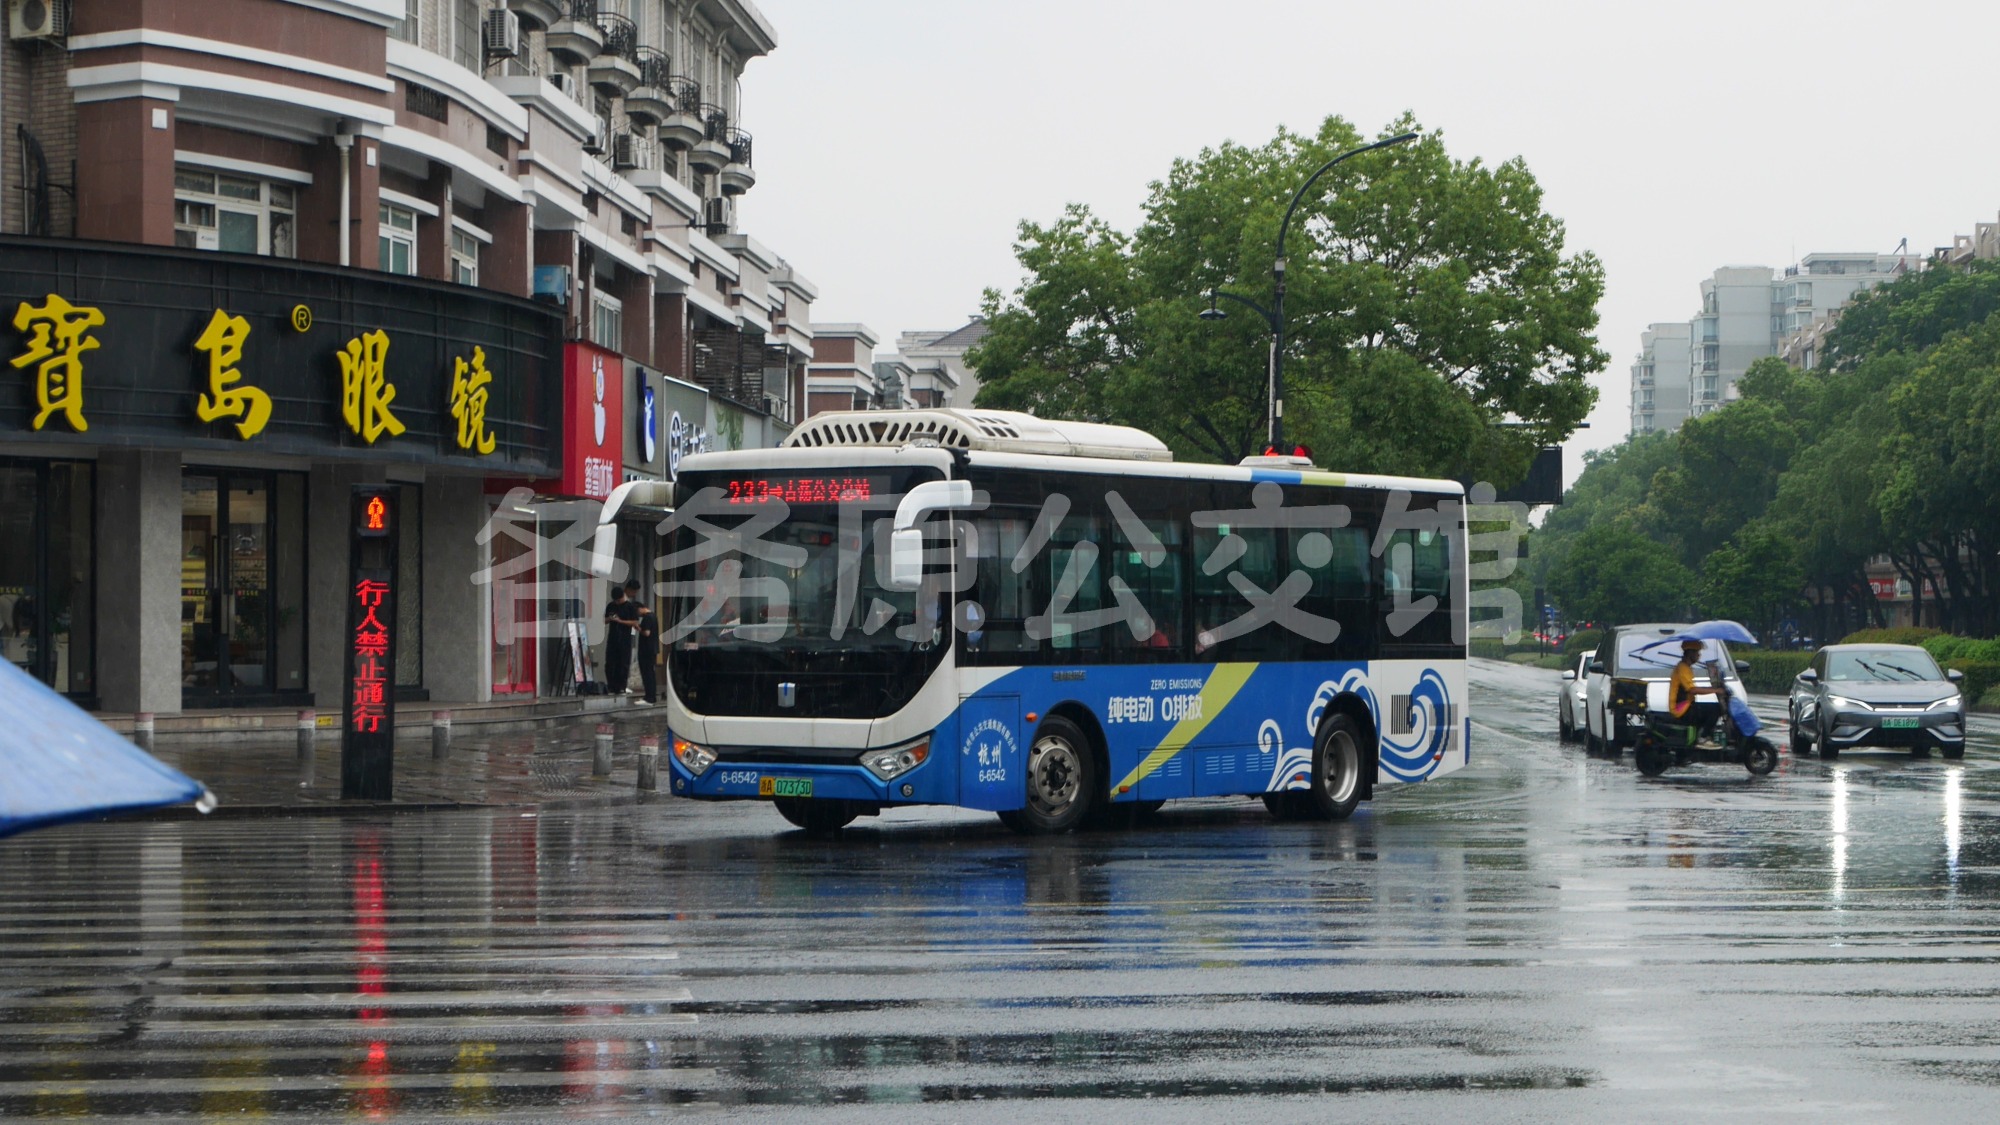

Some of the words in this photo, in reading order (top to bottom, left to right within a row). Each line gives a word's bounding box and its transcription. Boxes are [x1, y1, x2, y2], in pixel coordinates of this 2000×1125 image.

[584, 455, 613, 497] 蜜雪冰城
[729, 480, 768, 504] 233
[353, 579, 390, 732] 行人禁止通行
[1150, 679, 1167, 690] ZERO
[1169, 678, 1202, 690] EMISSIONS
[1107, 695, 1154, 723] 纯电动
[1161, 694, 1203, 721] 0排放
[978, 740, 1002, 769] 杭州
[720, 770, 758, 785] 6-6542
[979, 769, 1006, 783] 6-6542
